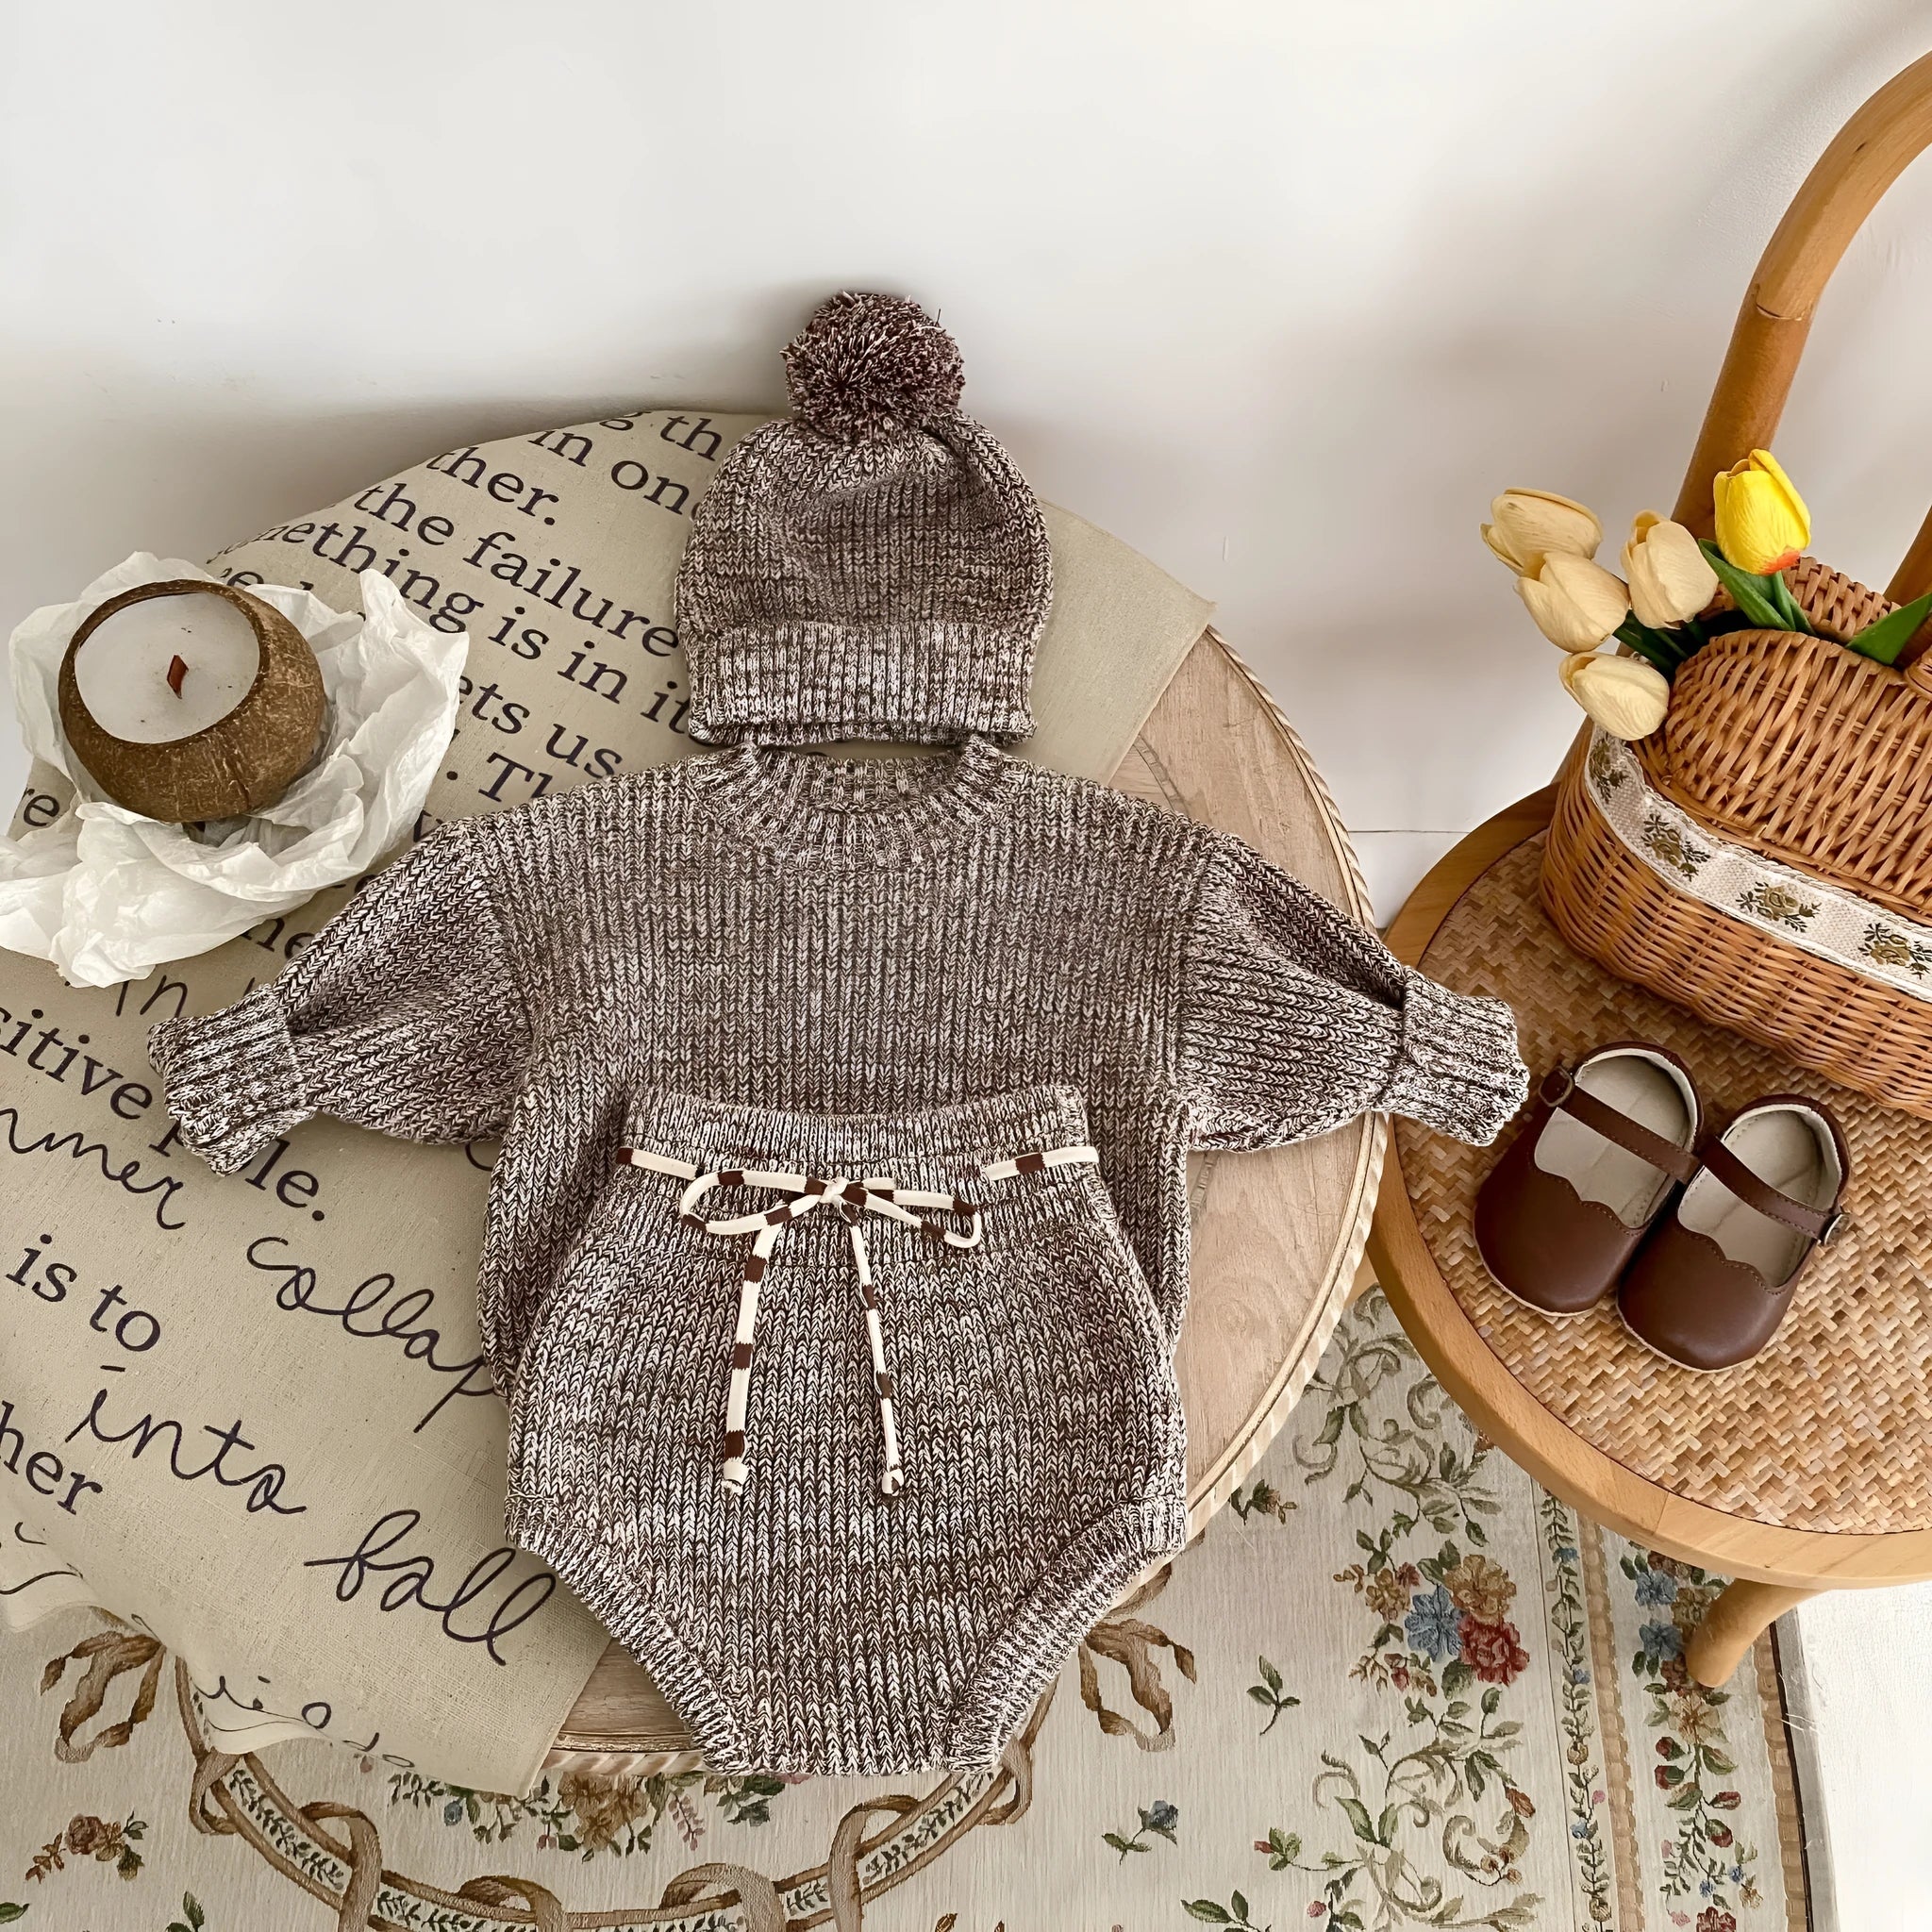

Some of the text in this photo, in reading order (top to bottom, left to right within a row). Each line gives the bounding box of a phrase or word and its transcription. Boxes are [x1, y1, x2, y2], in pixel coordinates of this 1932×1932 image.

[610, 459, 702, 520] on
[354, 482, 680, 658] the failure
[489, 606, 548, 660] is
[557, 640, 629, 705] in
[6, 1233, 161, 1352] is to
[64, 1364, 558, 1666] into fall
